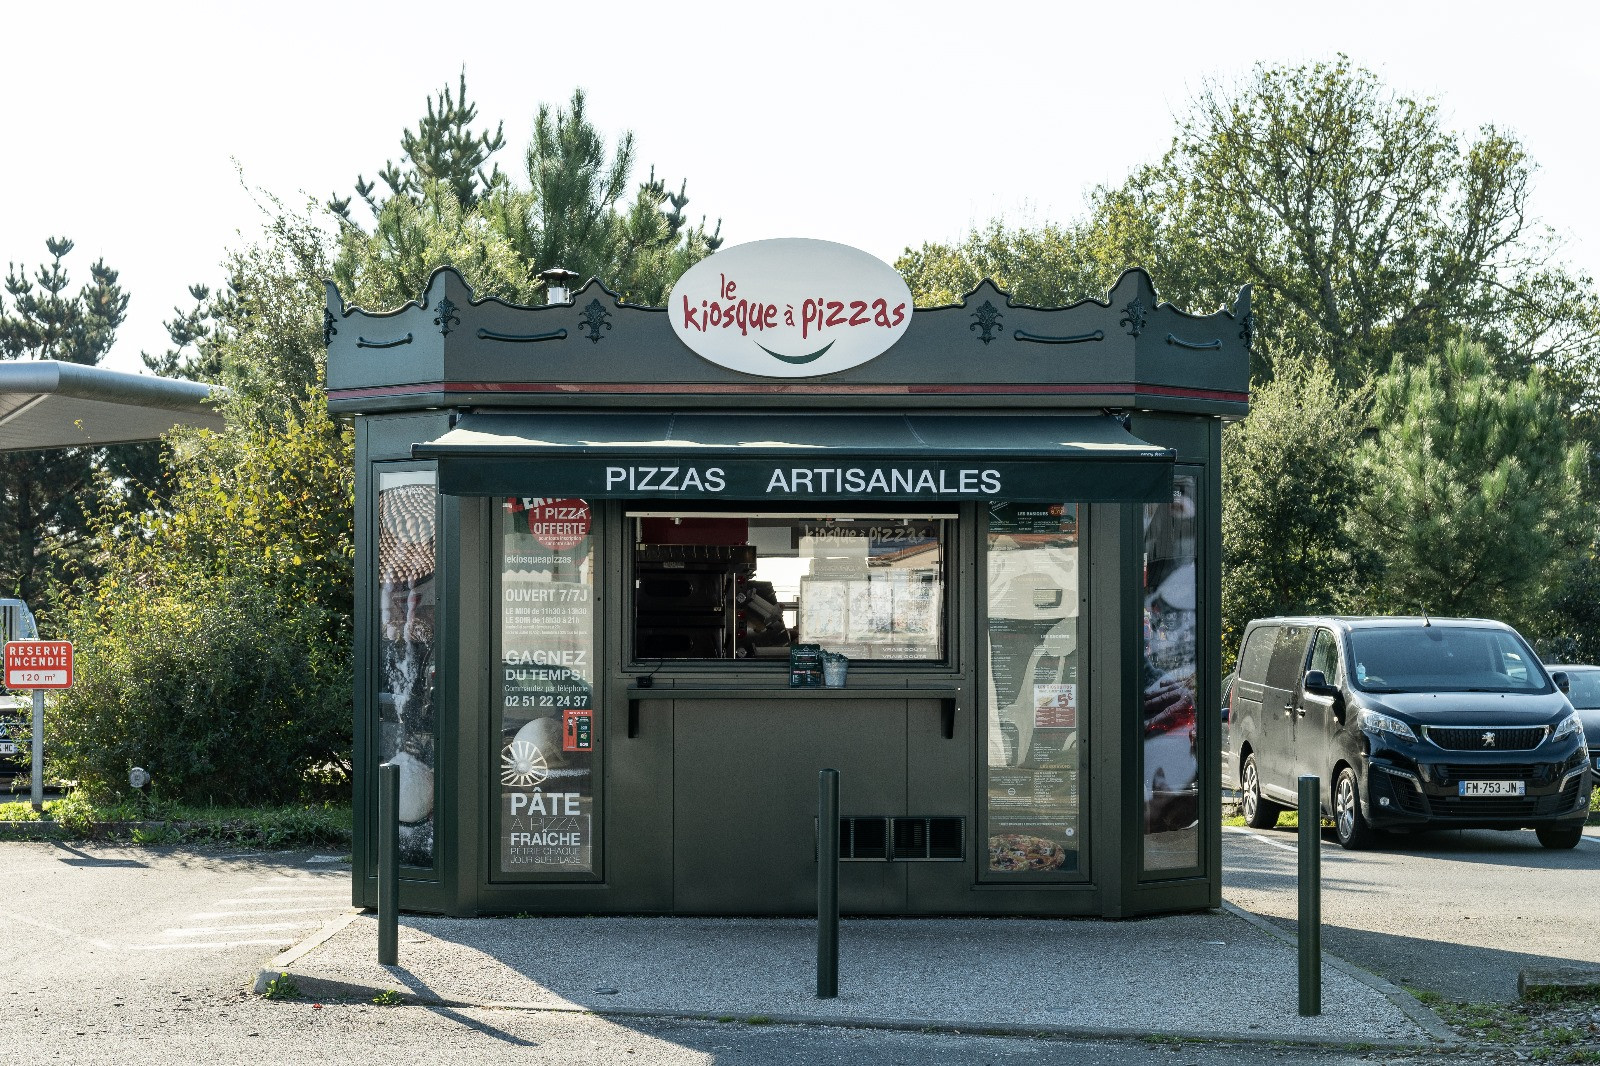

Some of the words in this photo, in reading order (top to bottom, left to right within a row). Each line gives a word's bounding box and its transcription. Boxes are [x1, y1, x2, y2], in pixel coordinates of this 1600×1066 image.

[720, 273, 737, 300] le
[683, 294, 778, 336] kiosque
[784, 304, 796, 327] à
[802, 298, 906, 339] pizzas
[605, 467, 726, 492] PIZZAS
[766, 468, 1002, 494] ARTISANALES
[533, 508, 540, 519] 1
[545, 508, 586, 519] PIZZA
[533, 522, 586, 534] OFFERTE
[804, 524, 857, 547] kiosque
[868, 526, 926, 549] pizzas
[505, 589, 555, 602] OUVERT
[559, 589, 588, 602] 7/7J
[505, 607, 514, 615] LE
[515, 607, 531, 615] MIDI
[531, 607, 540, 615] de
[541, 607, 561, 615] 11h30
[505, 616, 514, 624] LE
[515, 616, 531, 624] SOIR
[532, 616, 541, 624] de
[9, 646, 67, 656] RESERVE
[9, 656, 67, 666] INCENDIE
[505, 650, 587, 666] GAGNEZ
[21, 673, 40, 682] 120
[505, 669, 527, 681] DU
[504, 684, 544, 692] Commandez
[557, 684, 589, 694] téléphone
[505, 695, 520, 707] 02
[522, 695, 535, 707] 51
[539, 695, 554, 707] 22
[556, 695, 571, 707] 24
[573, 695, 588, 707] 37
[1466, 782, 1517, 794] FM-753-JN
[510, 786, 581, 816] PÂTE
[530, 816, 580, 831] PIZZA
[510, 829, 581, 846] FRAÎCHE
[543, 847, 581, 856] CHAQUE
